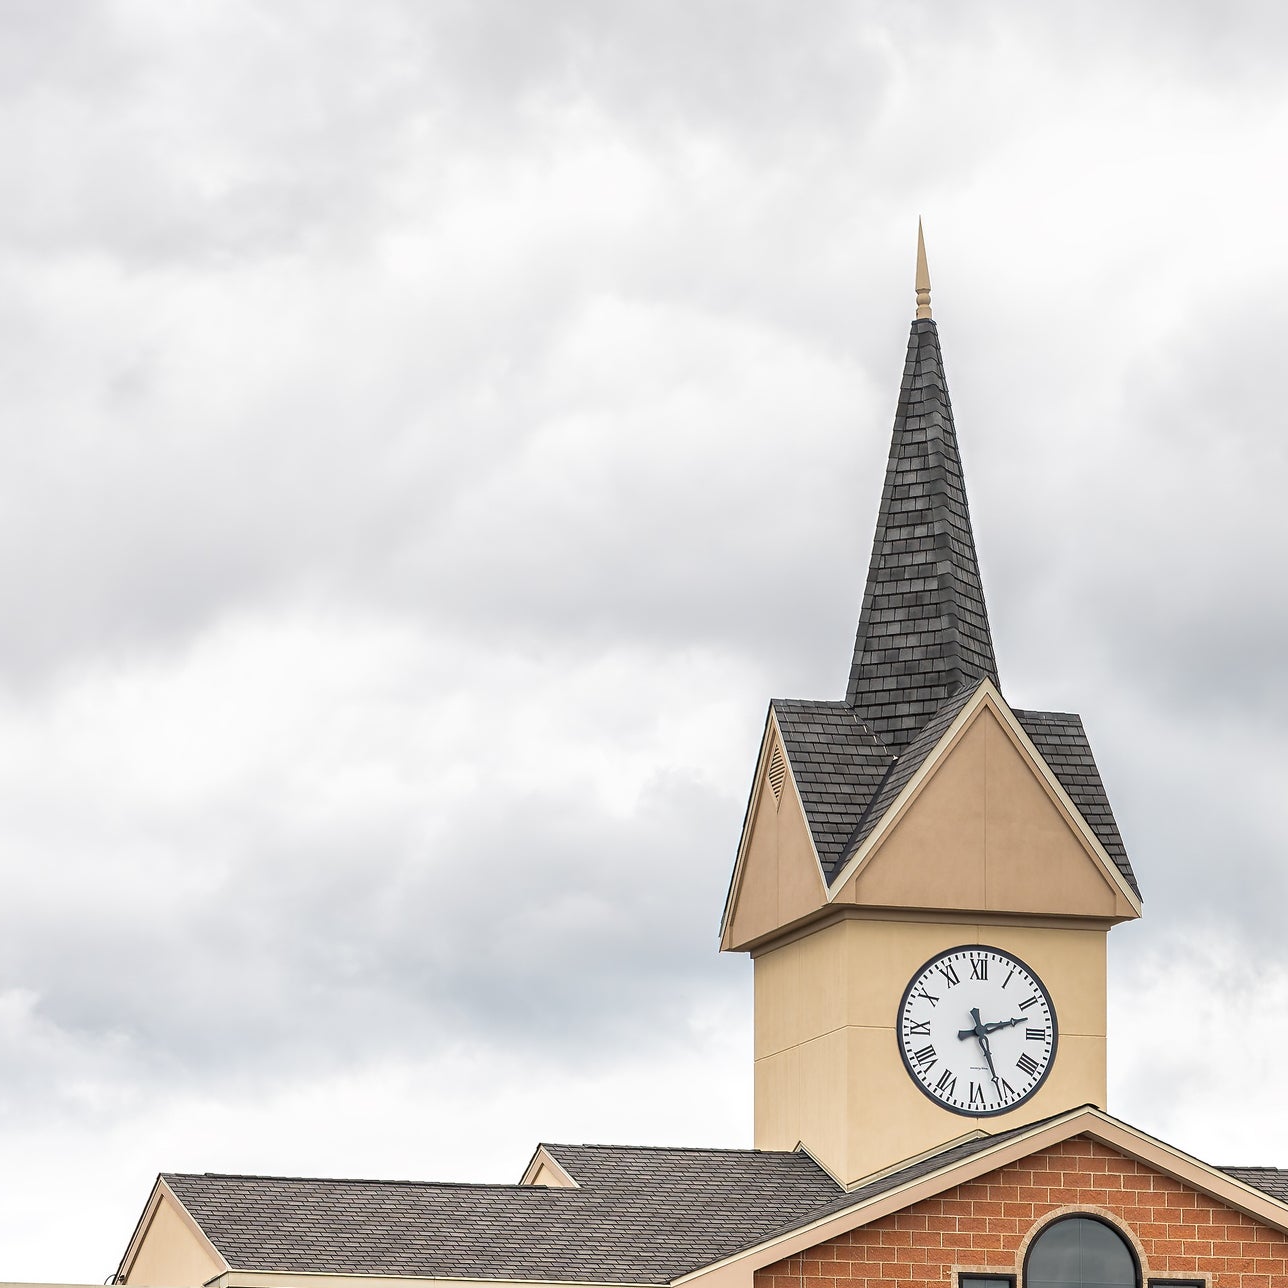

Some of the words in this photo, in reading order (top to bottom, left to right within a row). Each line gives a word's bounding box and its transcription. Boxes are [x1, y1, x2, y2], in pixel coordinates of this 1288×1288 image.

[939, 964, 960, 988] XI
[970, 958, 988, 980] XII
[1002, 970, 1014, 989] I
[918, 987, 940, 1008] X
[1018, 995, 1038, 1012] II
[910, 1020, 930, 1036] IX
[1026, 1028, 1046, 1041] III
[914, 1044, 938, 1074] VIII
[936, 1069, 958, 1097] VII
[969, 1082, 985, 1104] VI
[1001, 1078, 1015, 1098] V
